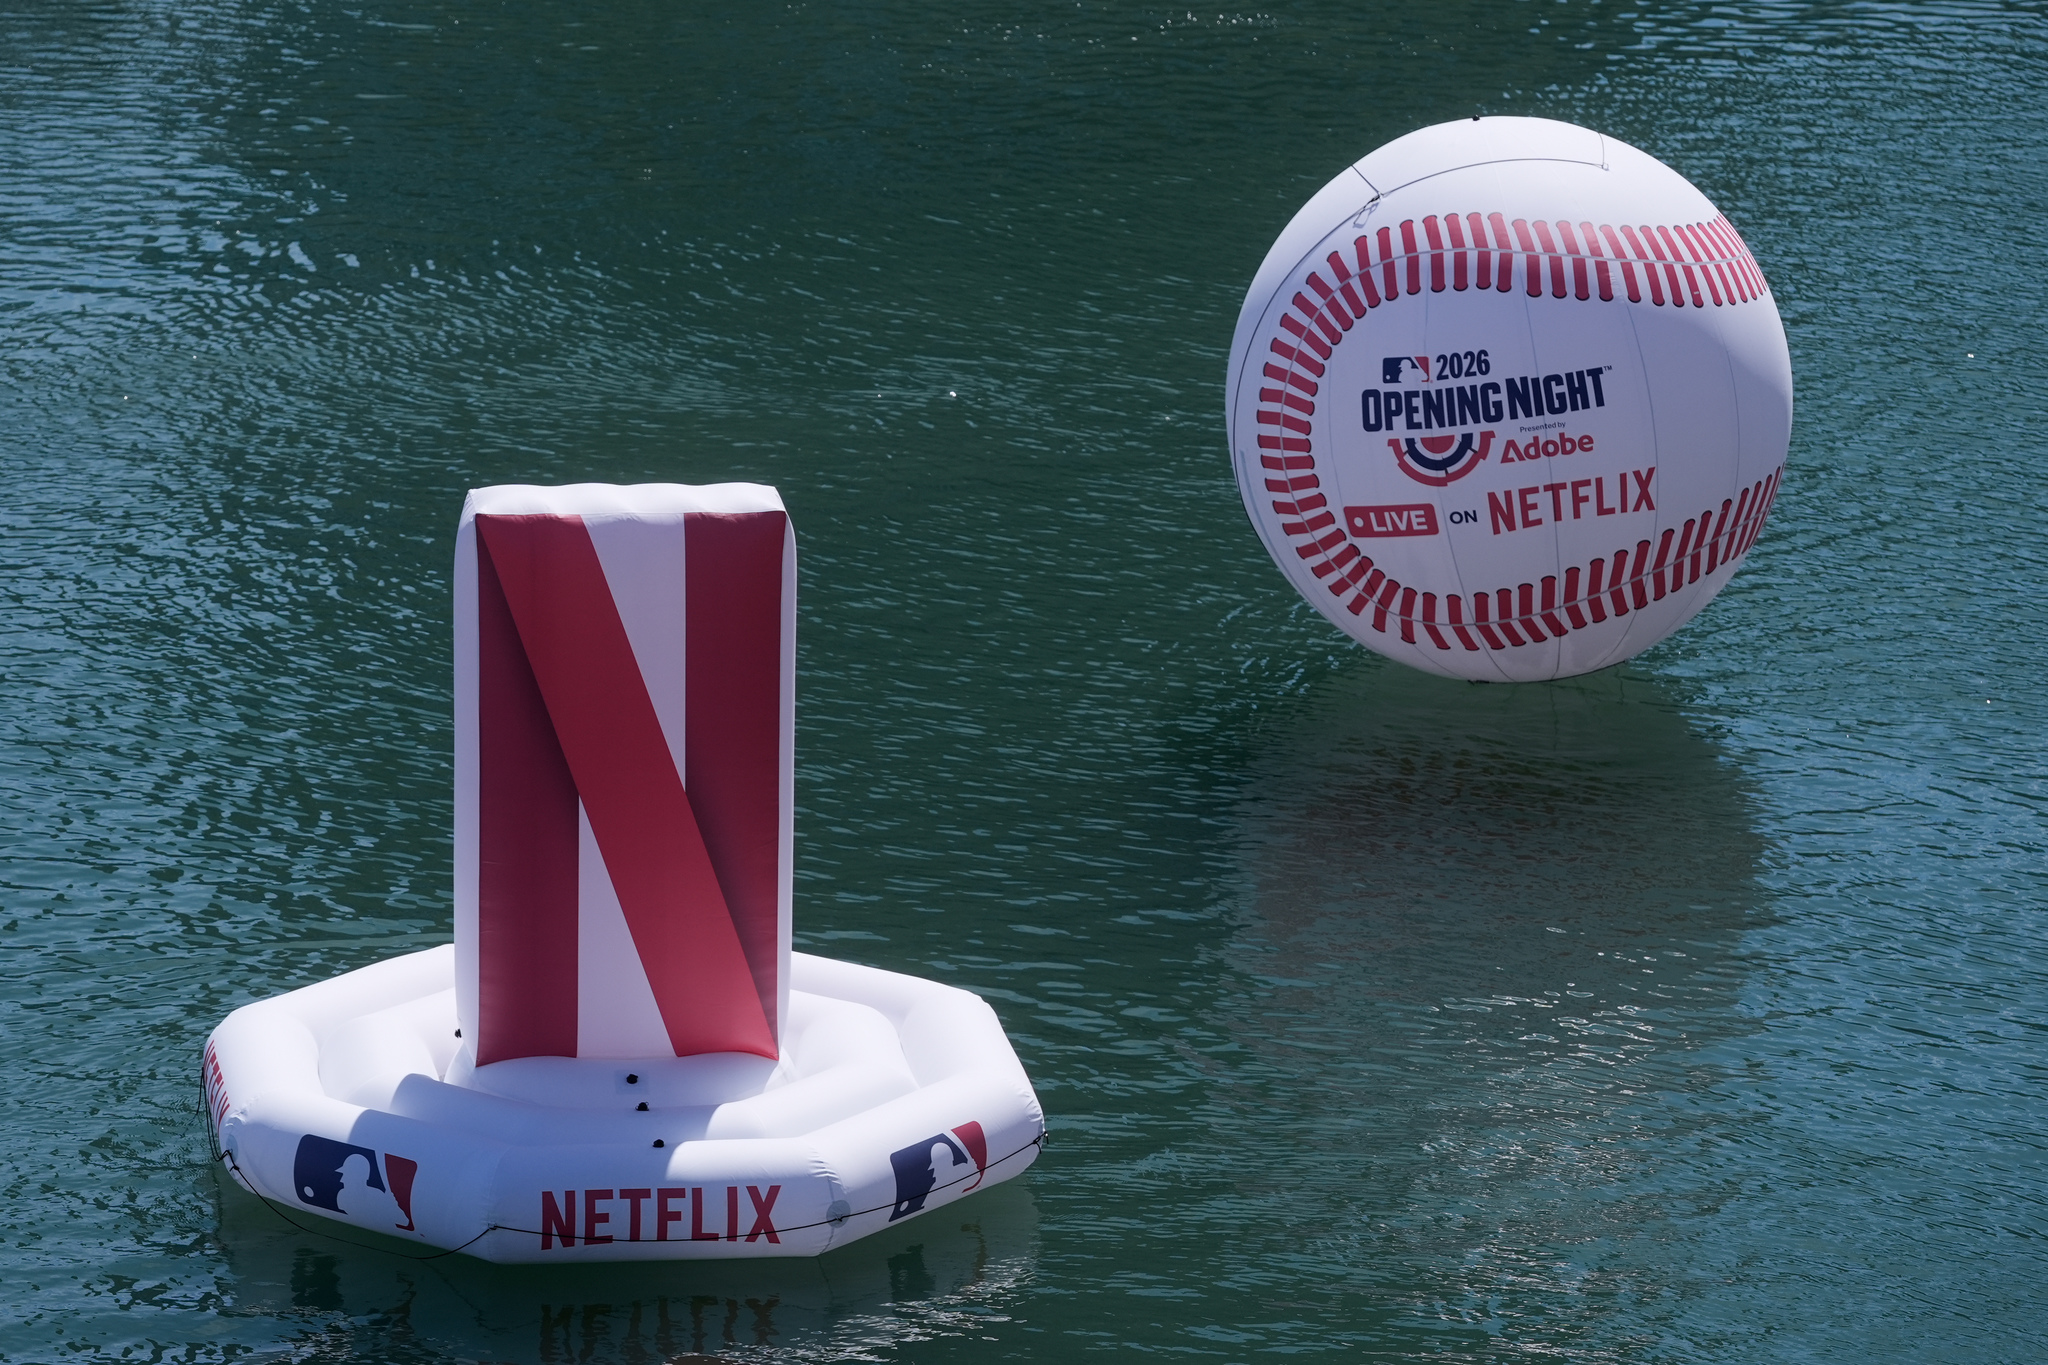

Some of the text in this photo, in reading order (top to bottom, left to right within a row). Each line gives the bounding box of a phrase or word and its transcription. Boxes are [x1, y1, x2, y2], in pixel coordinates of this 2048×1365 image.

[1436, 349, 1491, 381] 2026
[1361, 382, 1504, 432] OPENING
[1519, 421, 1566, 433] Presented by
[1500, 432, 1594, 464] Adobe
[1369, 466, 1656, 535] LIVE ON NETFLIX
[540, 1185, 782, 1251] NETFLIX
